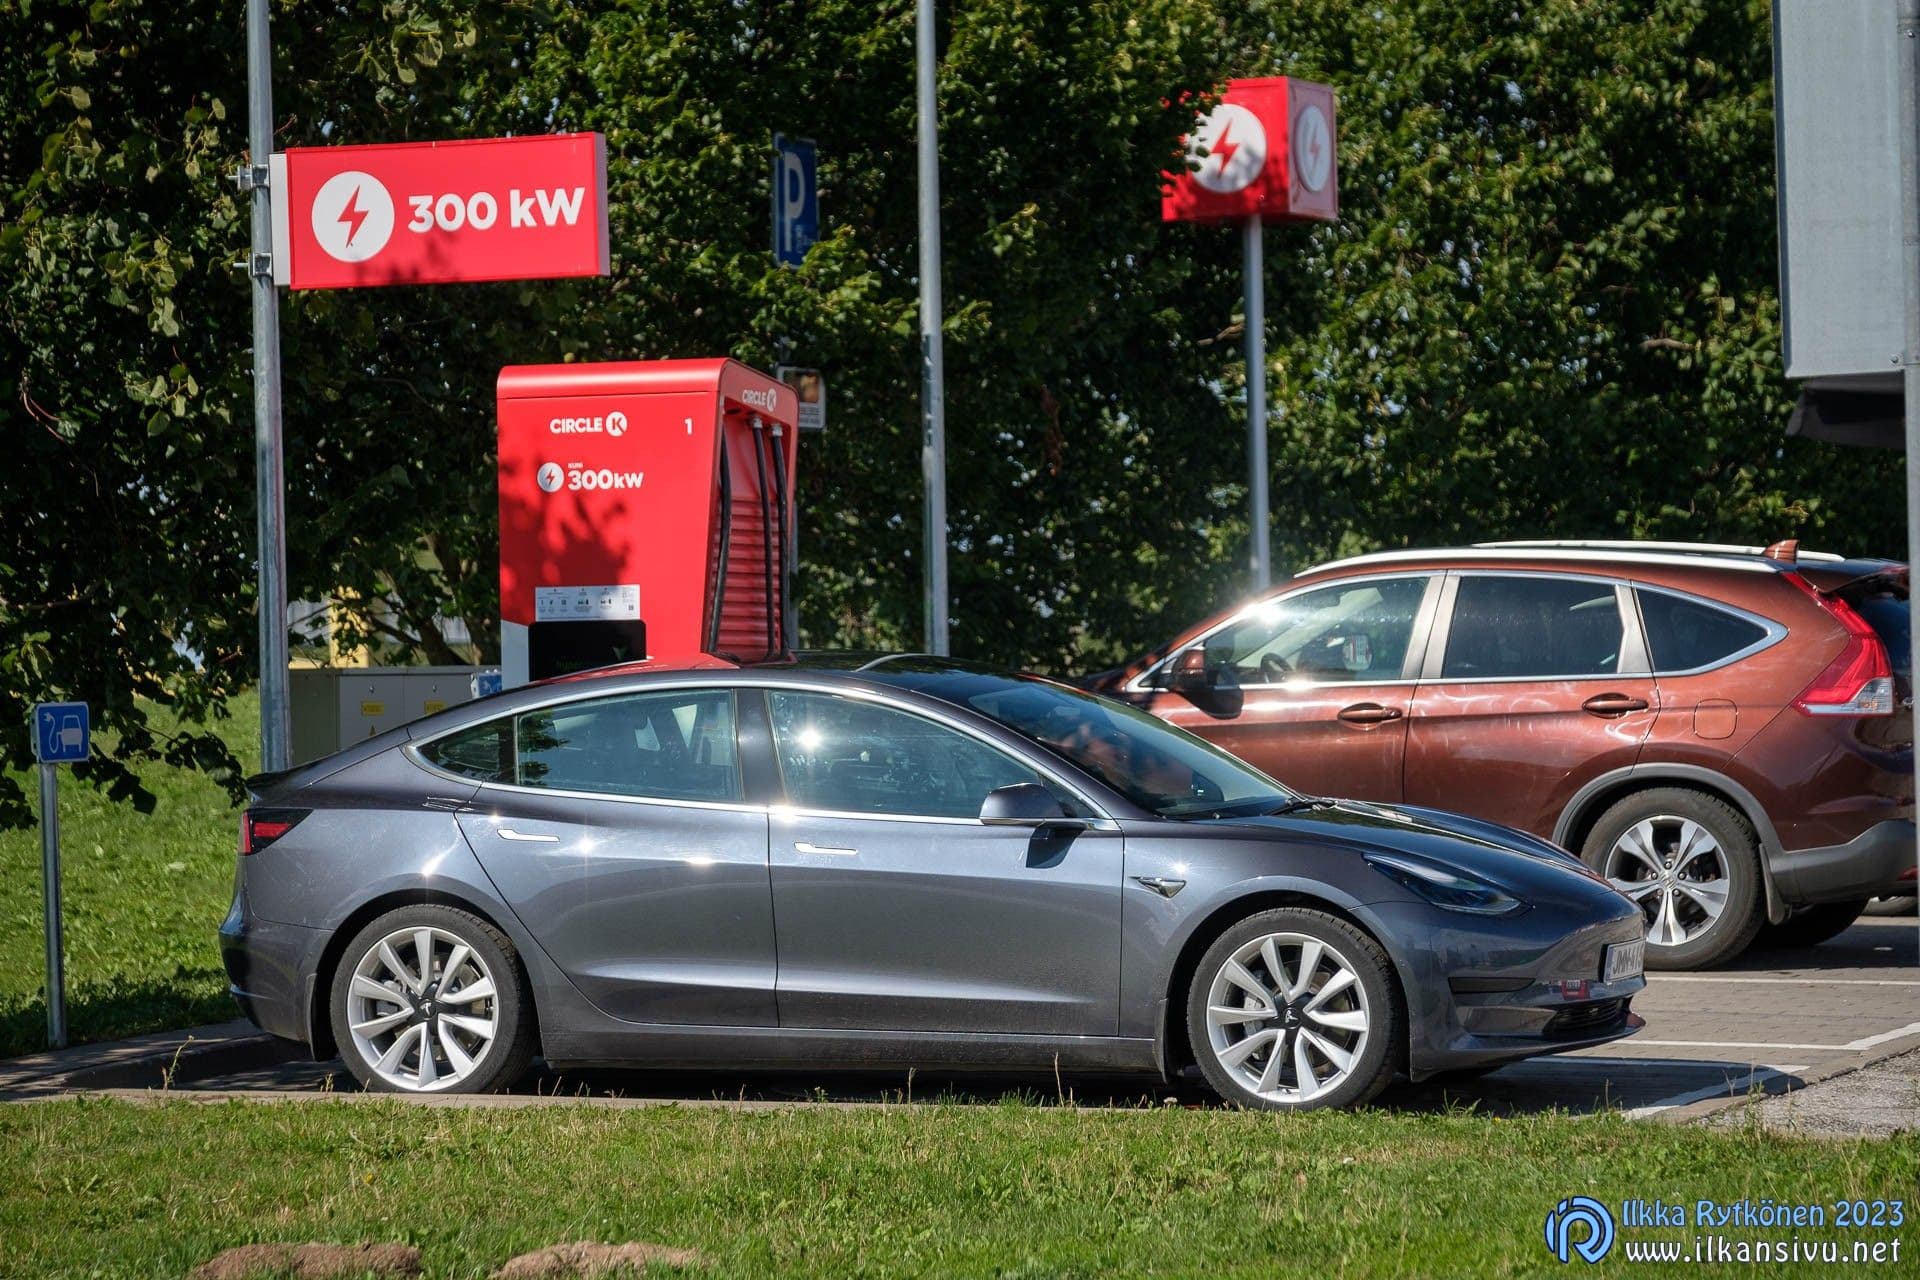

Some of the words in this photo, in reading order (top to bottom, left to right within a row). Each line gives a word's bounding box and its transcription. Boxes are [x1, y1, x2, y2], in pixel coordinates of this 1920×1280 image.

[407, 191, 498, 233] 300
[509, 187, 585, 228] kW
[783, 151, 806, 253] P
[550, 417, 603, 434] CIRCLE
[605, 411, 628, 437] K
[684, 418, 693, 435] 1
[567, 469, 644, 491] 300kW
